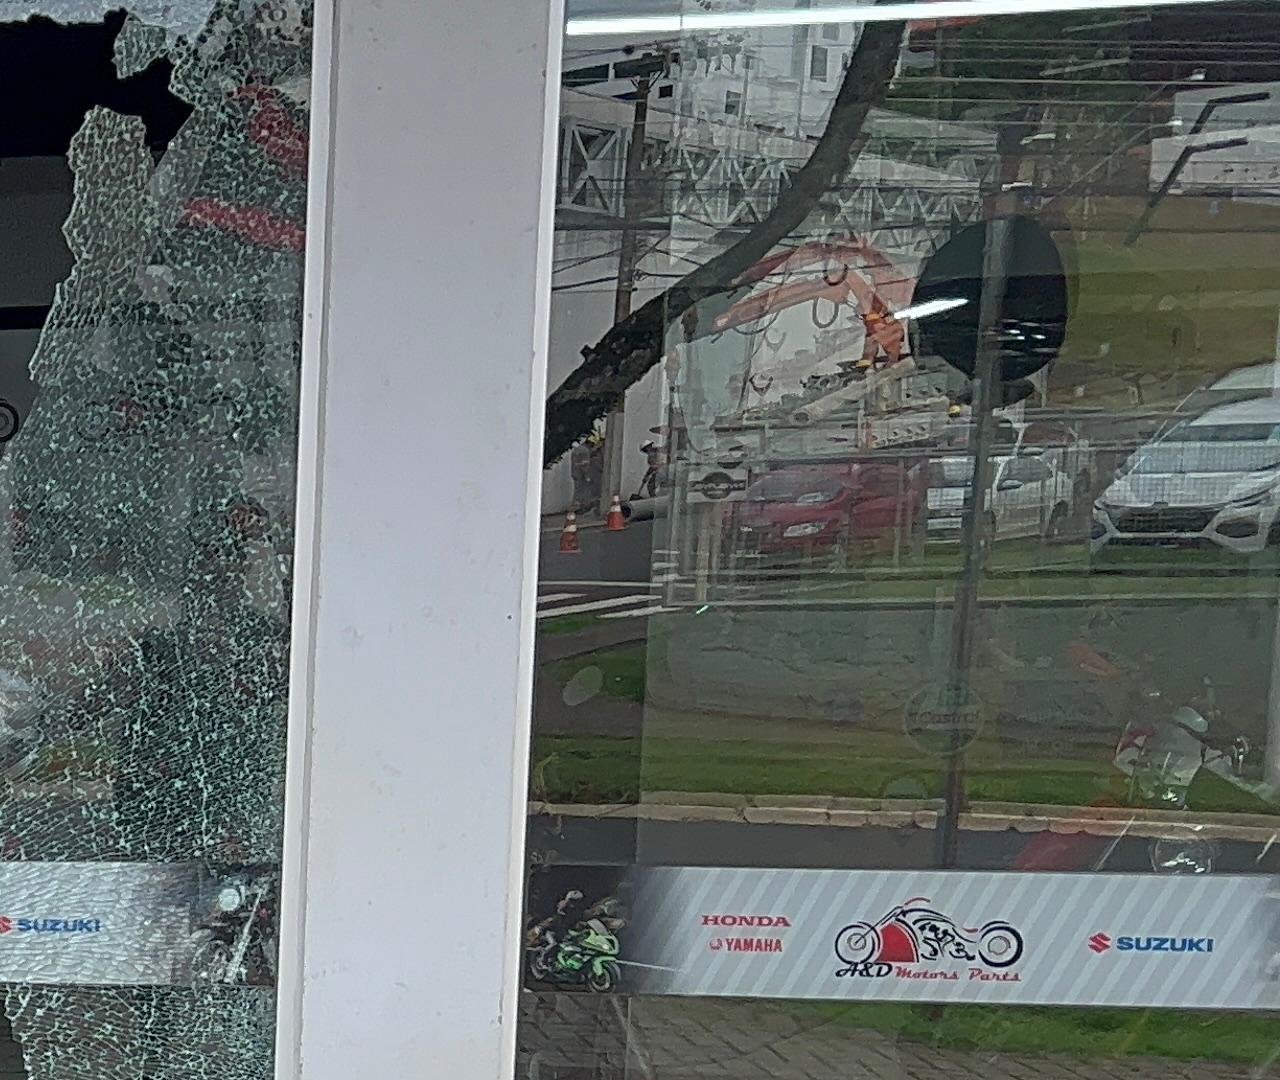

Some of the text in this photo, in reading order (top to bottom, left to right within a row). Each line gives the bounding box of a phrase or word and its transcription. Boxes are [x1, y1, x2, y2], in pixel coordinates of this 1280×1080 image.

[17, 917, 101, 933] SUZUKI
[702, 914, 791, 927] HONDA
[725, 938, 783, 953] YAMAHA
[1117, 935, 1214, 954] SUZUKI
[835, 963, 1022, 982] A&D Motors Parts
